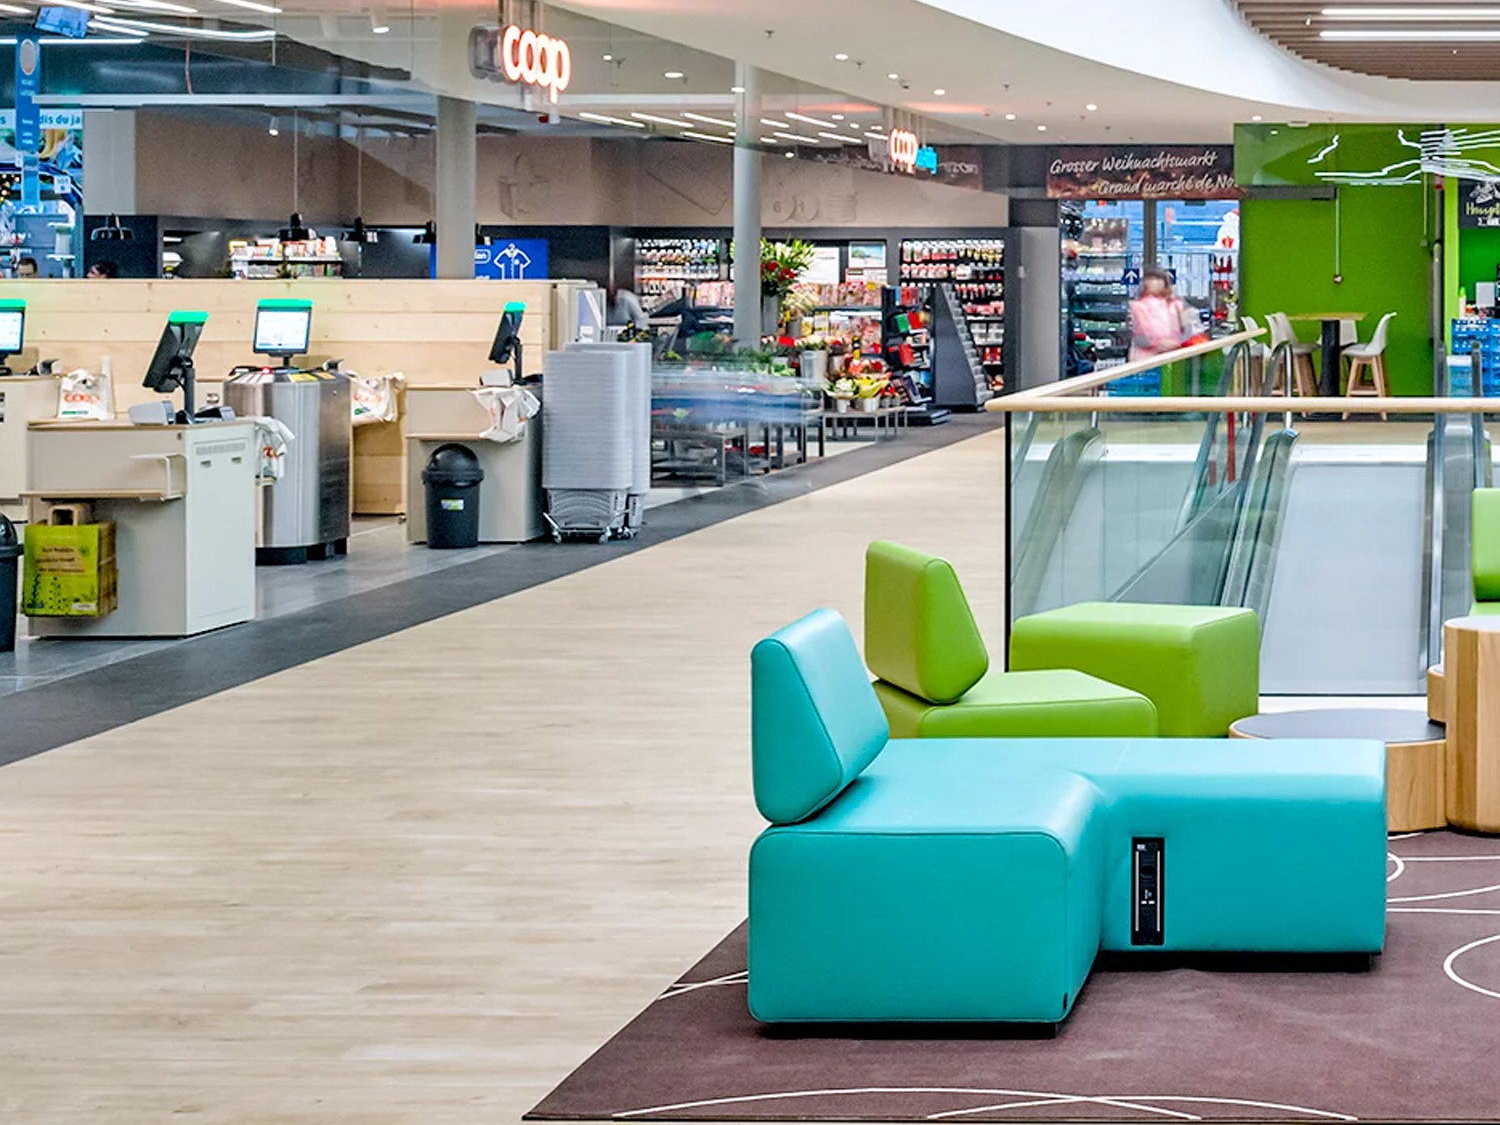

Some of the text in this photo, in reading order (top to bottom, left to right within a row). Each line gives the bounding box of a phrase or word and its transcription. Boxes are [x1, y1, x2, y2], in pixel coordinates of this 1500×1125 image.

[503, 23, 571, 104] coop
[1049, 159, 1100, 175] Grosser
[1194, 173, 1215, 191] de
[1215, 174, 1239, 189] No
